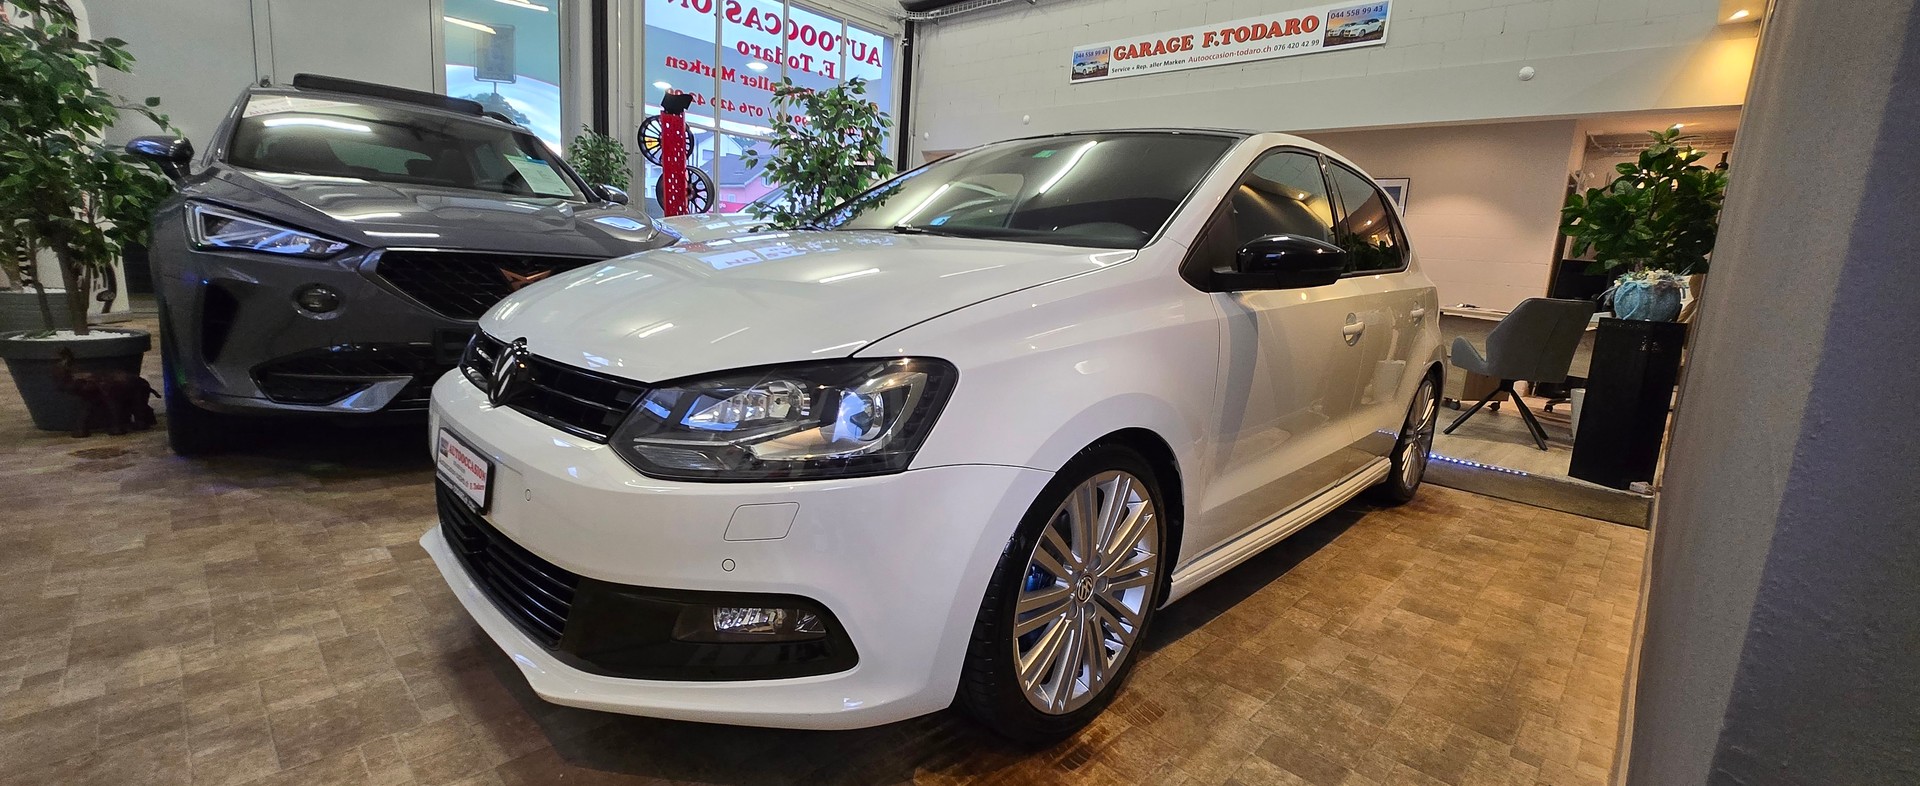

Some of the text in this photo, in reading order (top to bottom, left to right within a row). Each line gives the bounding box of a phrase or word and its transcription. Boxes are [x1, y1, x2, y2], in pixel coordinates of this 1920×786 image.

[1331, 11, 1344, 19] 044
[1346, 9, 1360, 18] 558
[1113, 15, 1320, 61] GARAGE F.TODARO
[1111, 66, 1130, 74] Service
[1136, 62, 1149, 71] Rep.
[1163, 58, 1186, 67] Marken
[1188, 46, 1272, 63] Autooccasion-todaro.ch
[1273, 43, 1286, 51] 076
[1287, 42, 1300, 50] 420
[1311, 39, 1320, 47] 99
